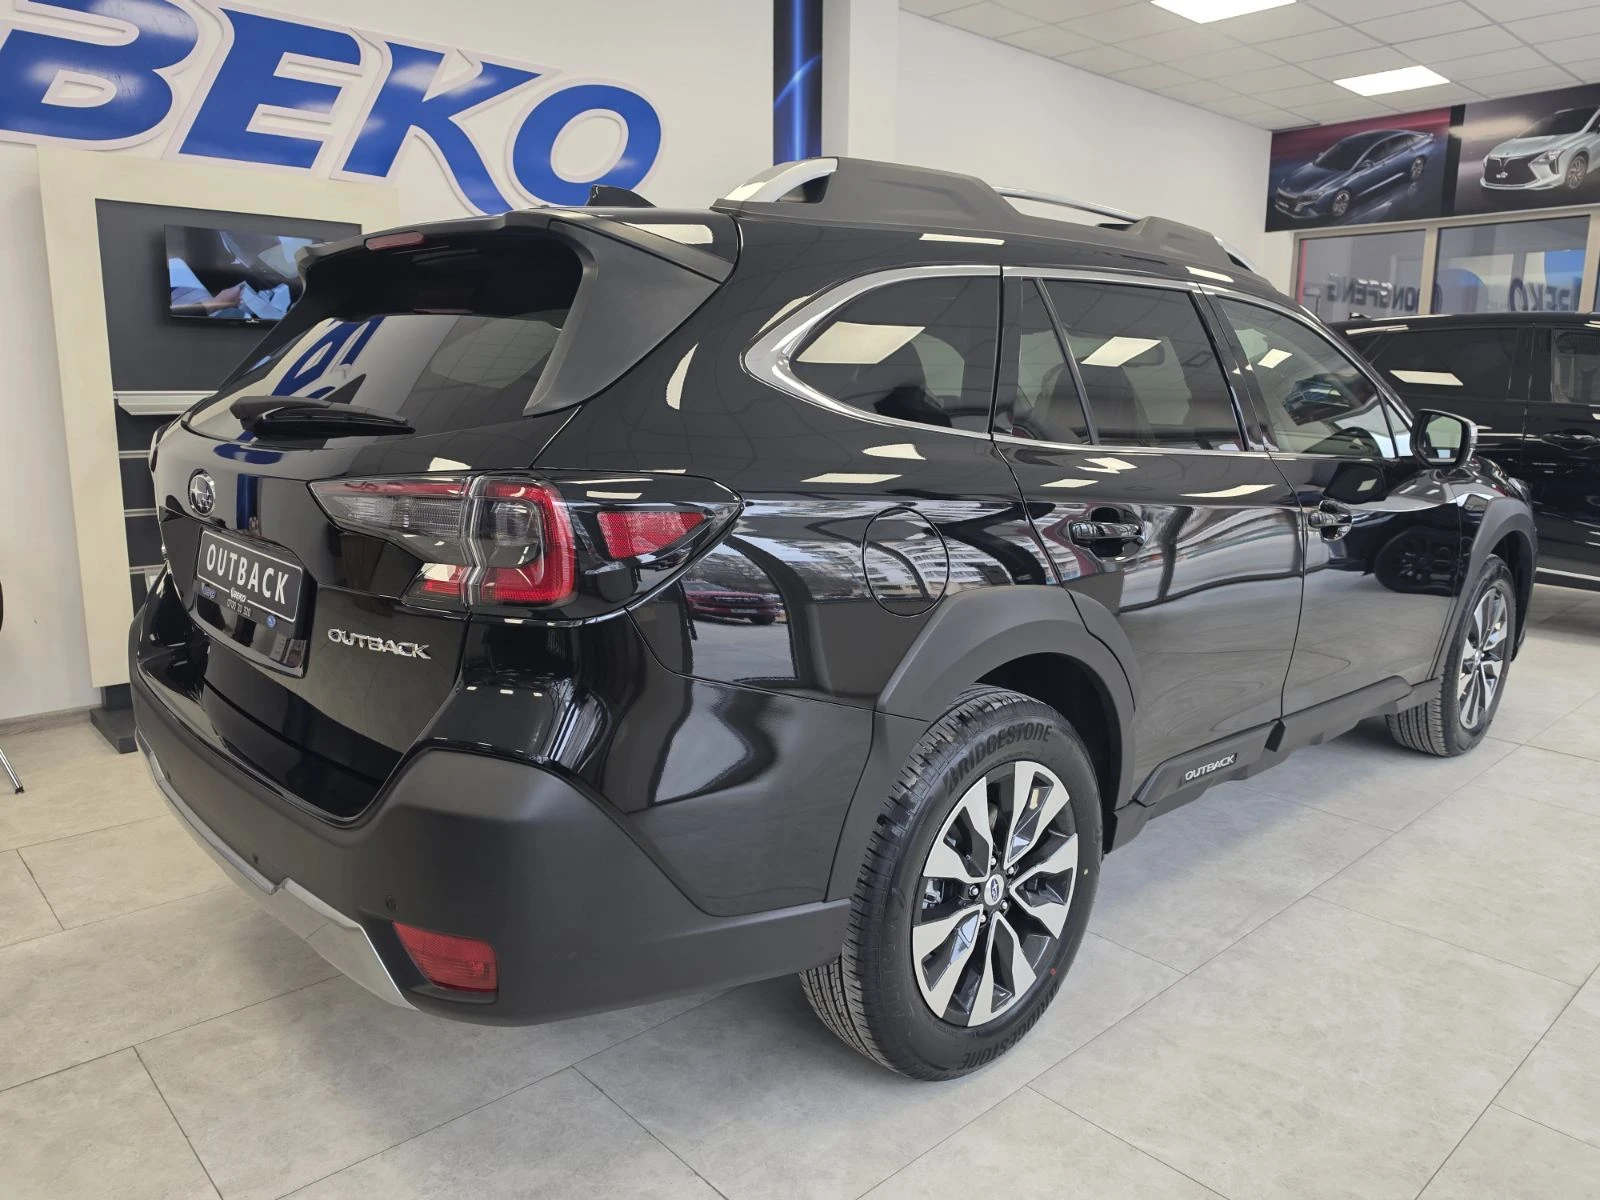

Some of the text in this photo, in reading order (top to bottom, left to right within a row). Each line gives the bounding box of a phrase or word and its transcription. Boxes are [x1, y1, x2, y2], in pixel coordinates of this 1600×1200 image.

[0, 0, 662, 214] BEKO
[206, 543, 289, 605] OUTBACK
[327, 628, 431, 659] OUTBACK
[943, 722, 1052, 796] BRIDGESTONE
[1184, 754, 1235, 781] OUTBACK
